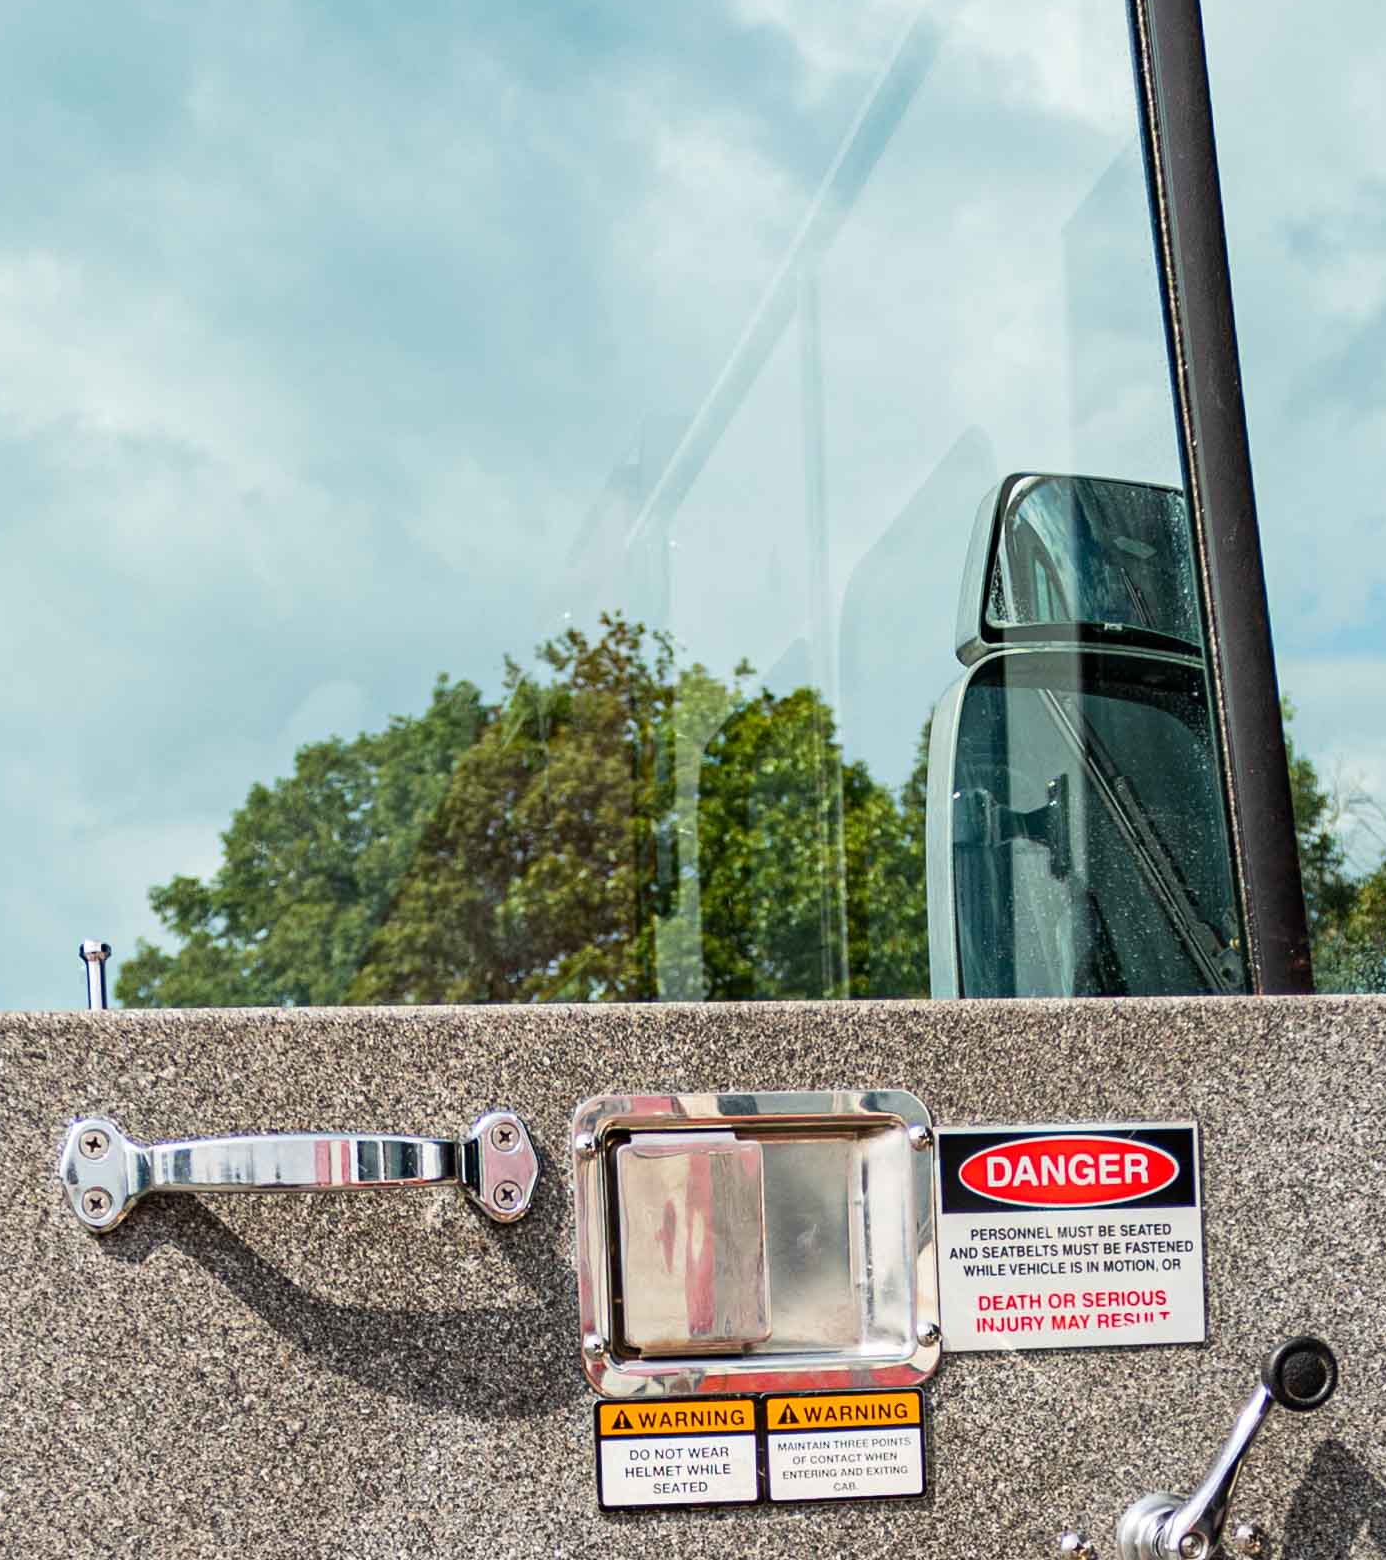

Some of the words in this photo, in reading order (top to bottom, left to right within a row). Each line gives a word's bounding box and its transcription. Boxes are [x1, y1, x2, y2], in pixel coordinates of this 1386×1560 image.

[986, 1153, 1149, 1187] DANGER
[970, 1227, 1053, 1240] PERSONNEL
[1057, 1225, 1094, 1238] MUST
[1098, 1224, 1115, 1237] BE
[1120, 1223, 1171, 1236] SEATED
[949, 1248, 978, 1260] AND
[981, 1245, 1058, 1259] SEATBELTS
[1063, 1243, 1098, 1256] MUST
[1103, 1242, 1121, 1254] BE
[1125, 1240, 1194, 1254] FASTENED
[963, 1264, 1005, 1277] WHILE
[1009, 1262, 1066, 1275] VEHICLE
[1070, 1261, 1082, 1273] IS
[1086, 1260, 1100, 1273] IN
[1103, 1259, 1159, 1273] MOTION,
[1162, 1258, 1181, 1270] OR
[978, 1294, 1042, 1311] DEATH
[1048, 1292, 1075, 1308] OR
[1082, 1290, 1167, 1307] SERIOUS
[976, 1315, 1044, 1333] INJURY
[1051, 1314, 1091, 1330] MAY
[638, 1409, 745, 1427] WARNING
[803, 1403, 909, 1422] WARNING
[777, 1439, 831, 1451] MAINTAIN
[834, 1438, 869, 1449] THREE
[872, 1436, 912, 1447] POINTS
[629, 1448, 650, 1461] DO
[654, 1447, 682, 1460] NOT
[687, 1446, 729, 1458] WEAR
[792, 1454, 808, 1465] OF
[810, 1453, 863, 1464] CONTACT
[865, 1451, 897, 1462] WHEN
[625, 1465, 682, 1478] HELMET
[686, 1463, 731, 1476] WHILE
[782, 1469, 839, 1480] ENTERING
[841, 1467, 863, 1478] AND
[865, 1465, 909, 1476] EXITING
[653, 1481, 708, 1494] SEATED
